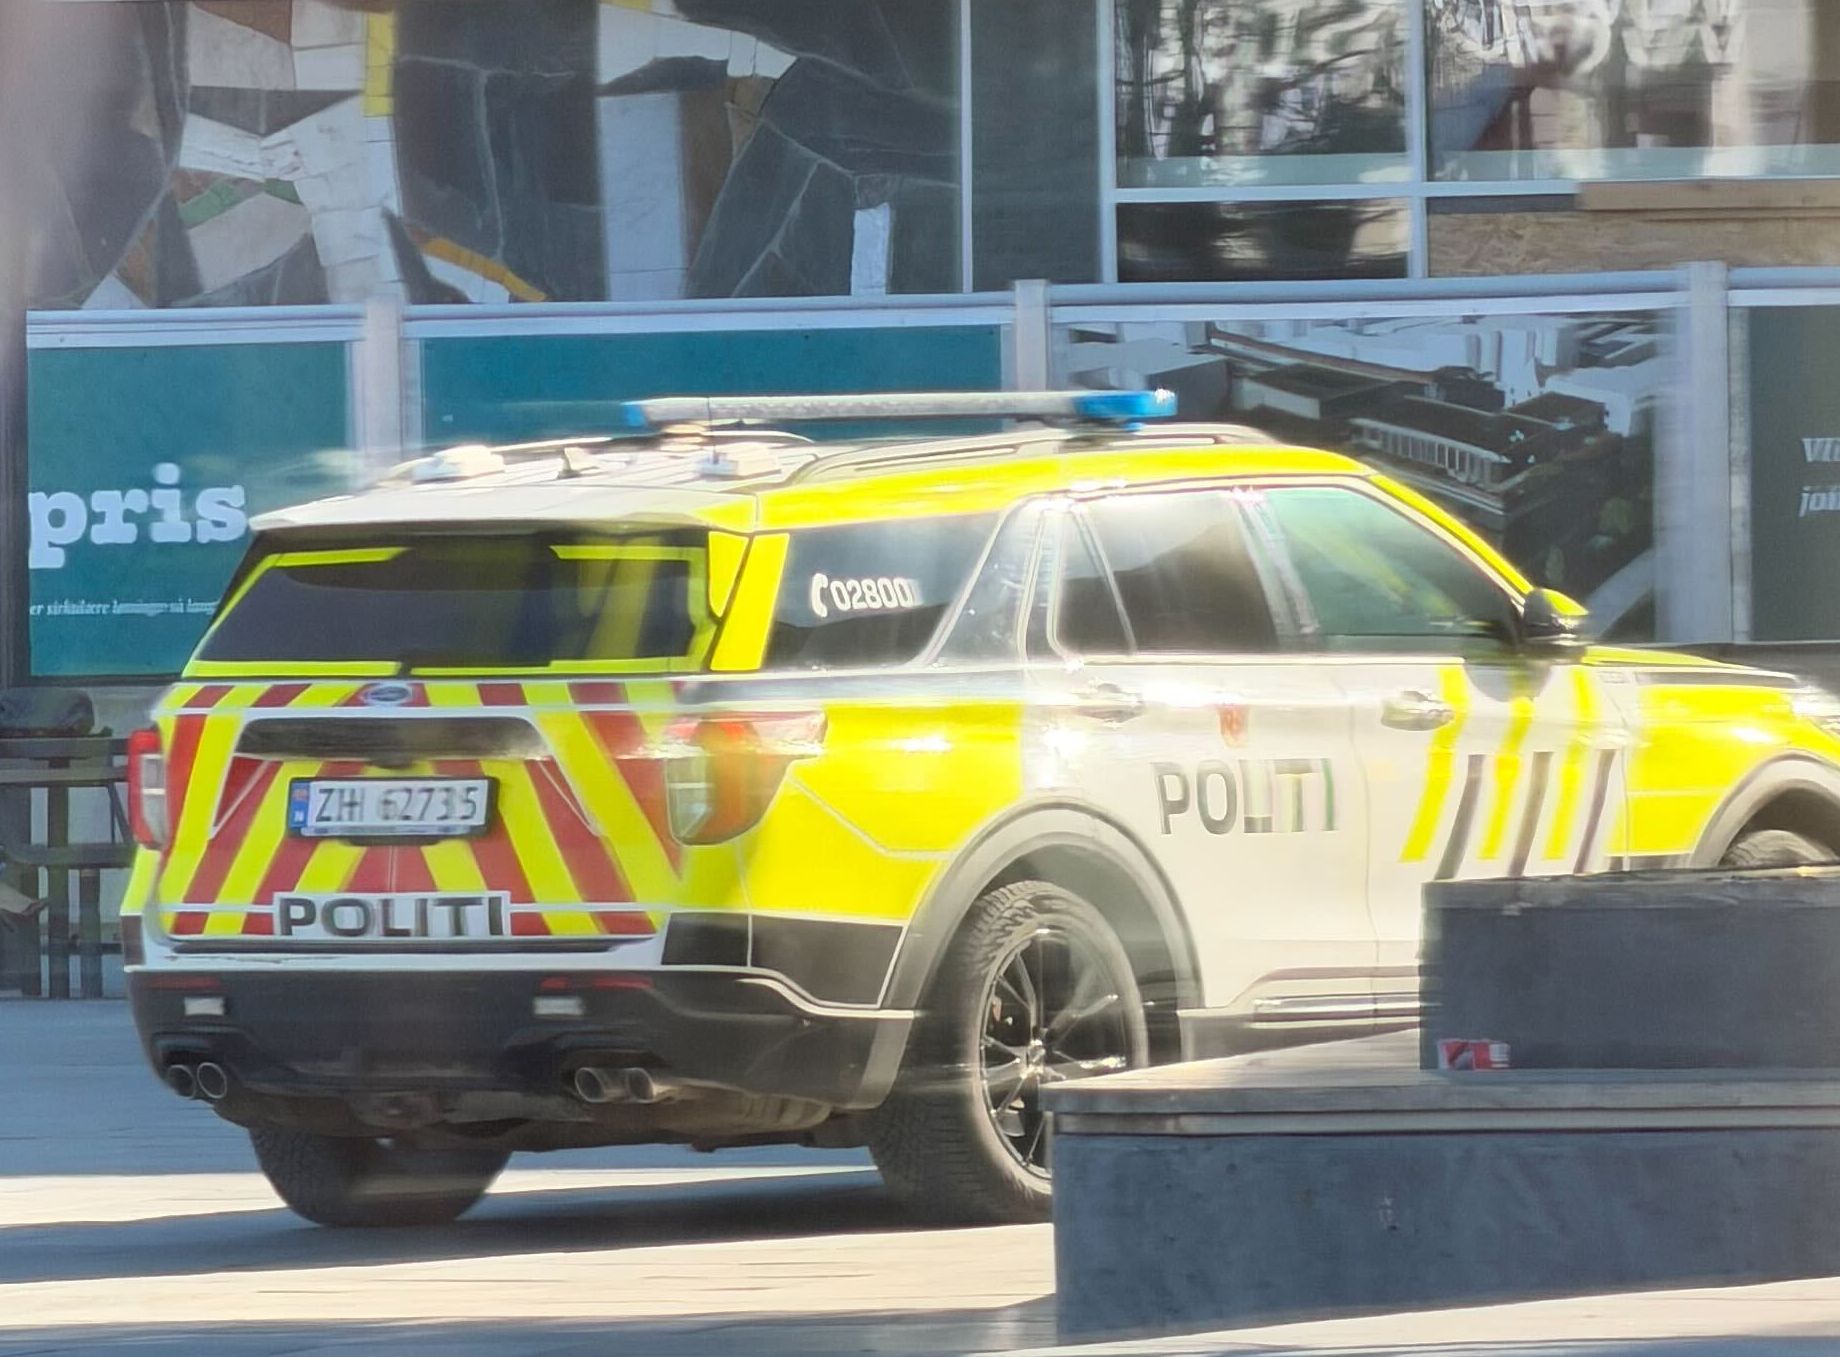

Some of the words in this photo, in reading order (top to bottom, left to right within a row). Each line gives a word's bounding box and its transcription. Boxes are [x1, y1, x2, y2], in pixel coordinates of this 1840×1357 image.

[28, 462, 247, 569] pris
[830, 577, 916, 611] 02800
[378, 786, 479, 822] 62735
[1150, 757, 1339, 835] POLITI
[279, 896, 504, 936] POLITI
